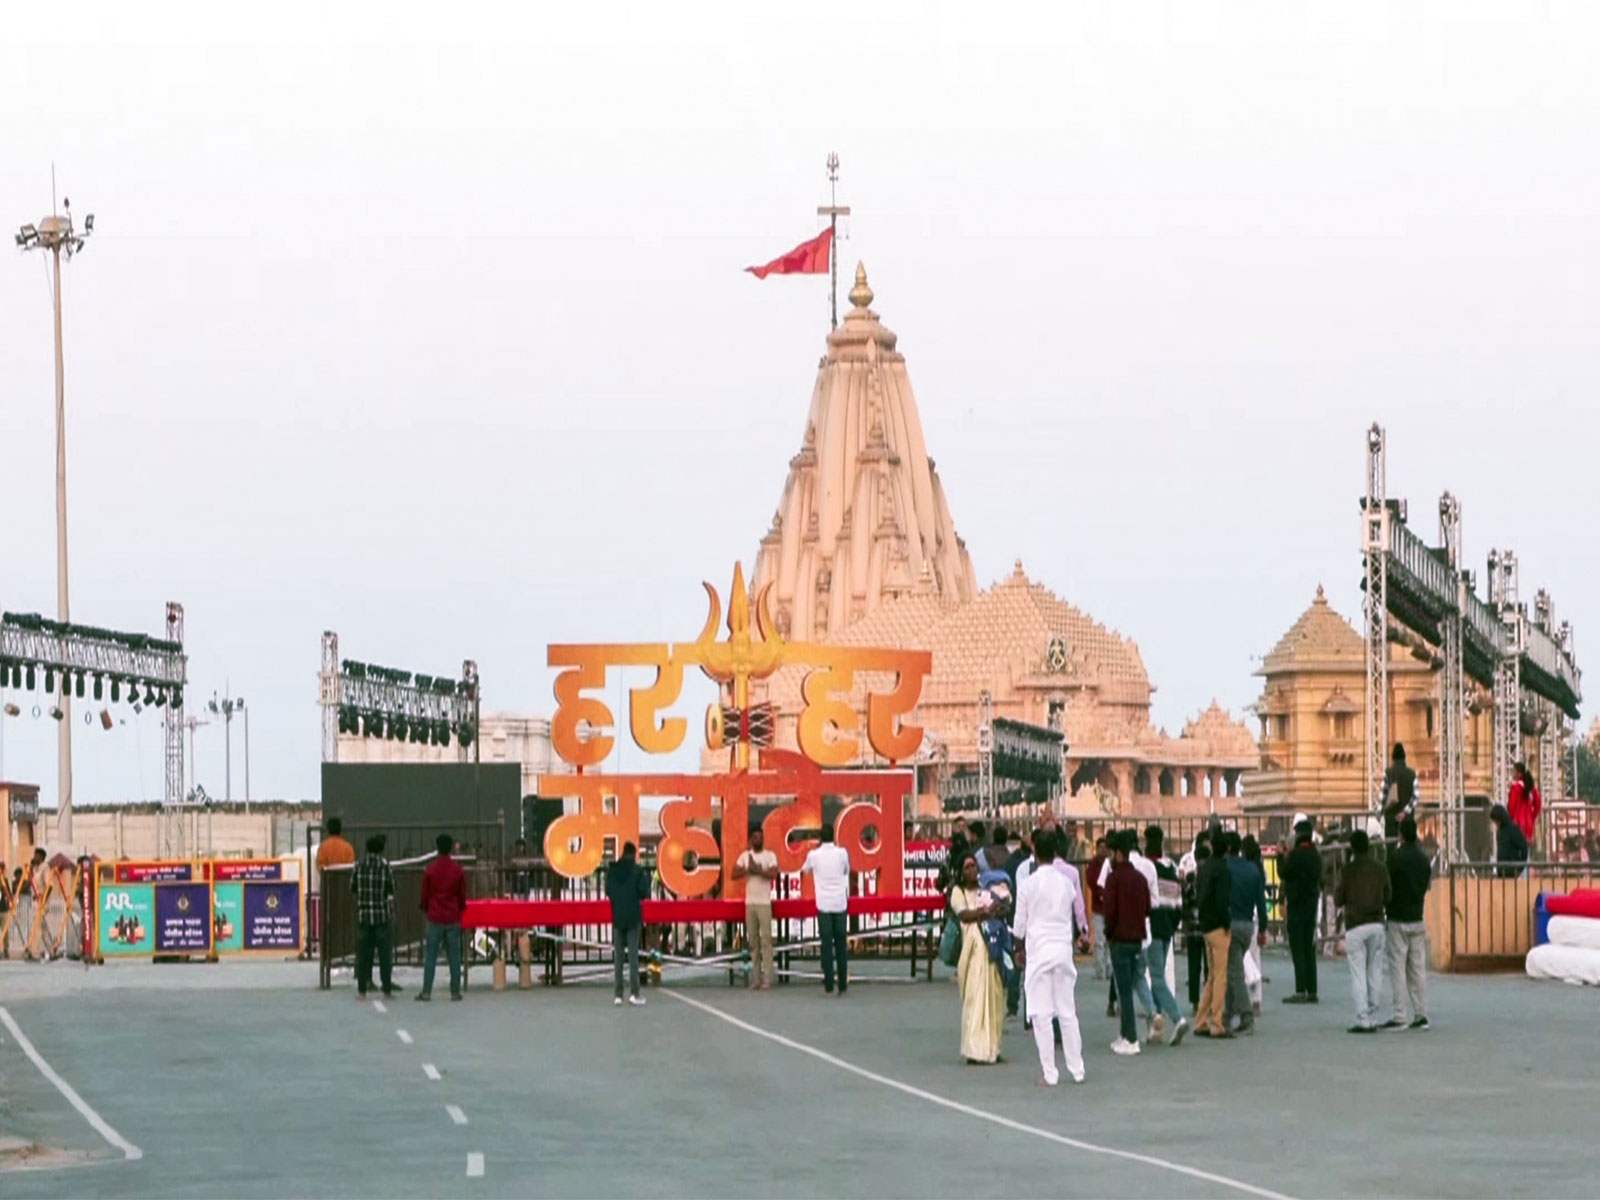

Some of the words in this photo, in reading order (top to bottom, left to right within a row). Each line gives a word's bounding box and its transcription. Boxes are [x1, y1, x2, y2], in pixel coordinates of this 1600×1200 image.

[547, 643, 697, 766] हर
[785, 644, 932, 768] हर
[538, 749, 913, 901] महादेव
